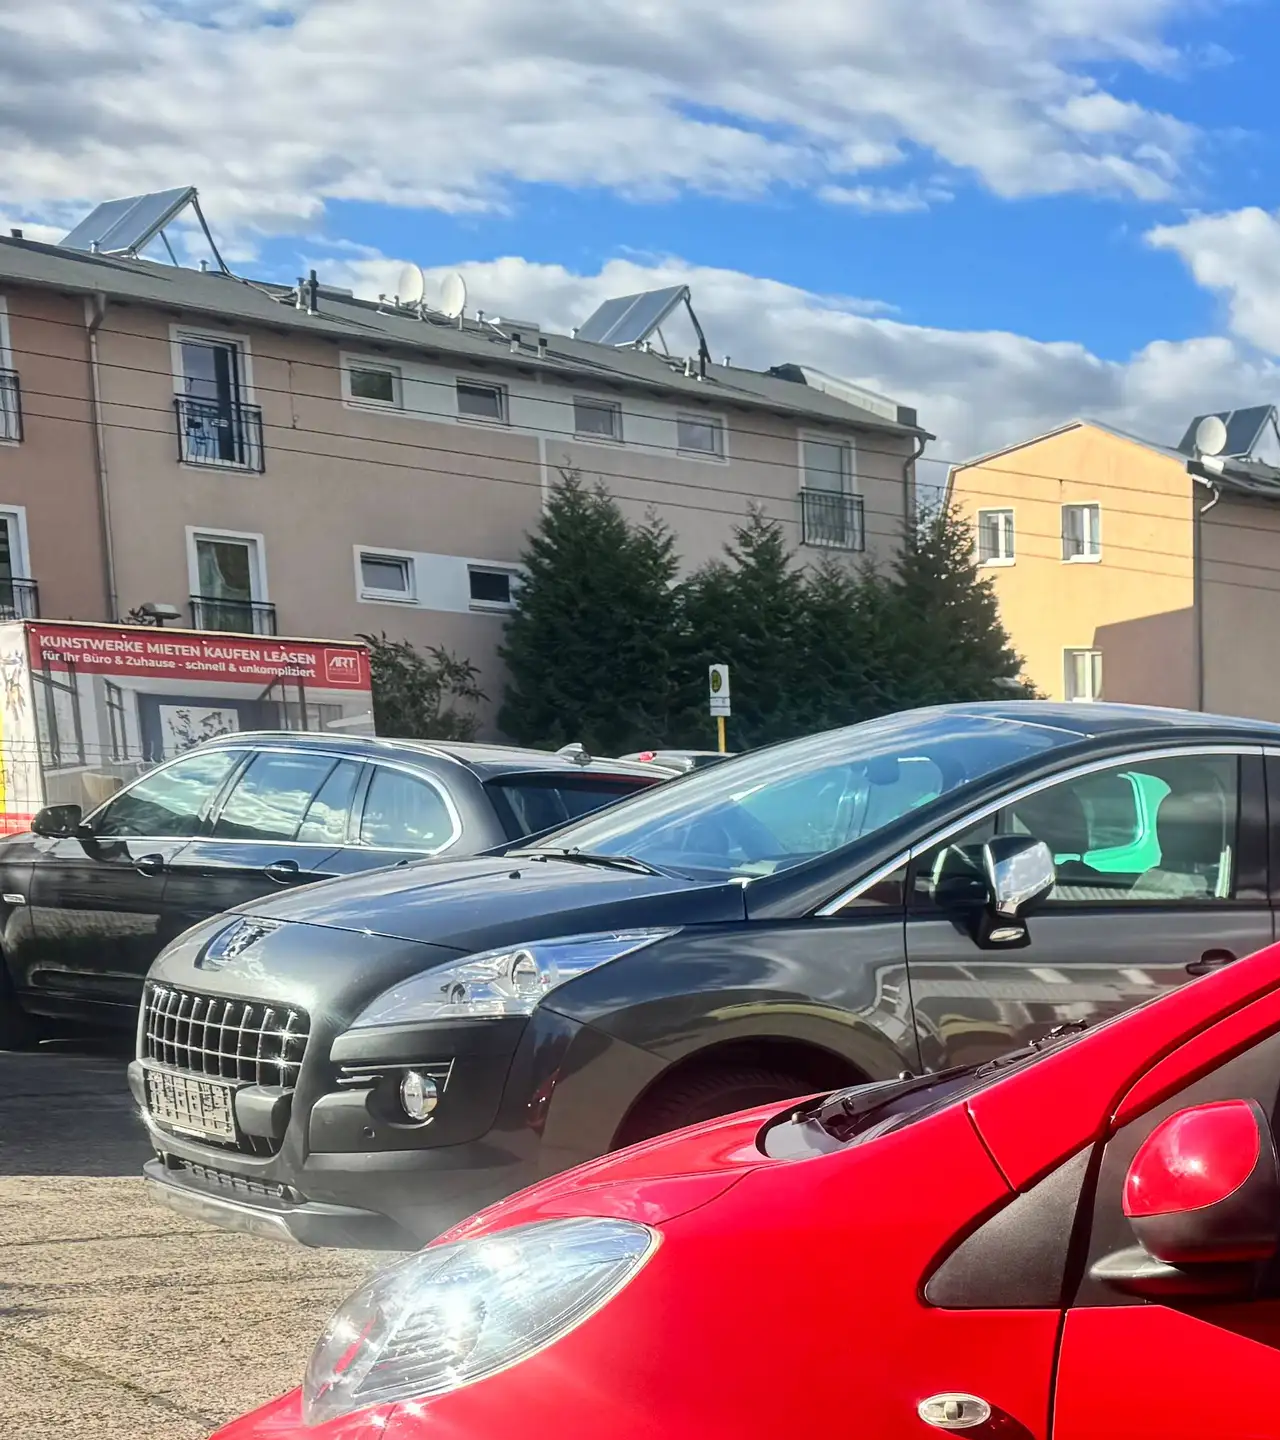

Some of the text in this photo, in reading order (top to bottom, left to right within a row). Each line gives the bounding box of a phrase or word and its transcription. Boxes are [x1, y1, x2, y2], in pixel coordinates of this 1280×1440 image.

[40, 635, 316, 665] KUNSTWERKE MIETEN KAUFEN LEASEN
[42, 650, 60, 662] für
[63, 652, 80, 663] Ihr
[83, 653, 112, 665] Büro
[115, 655, 124, 666] &
[125, 656, 176, 669] Zuhause
[185, 660, 225, 672] schnell
[228, 664, 237, 673] &
[239, 664, 316, 678] unkompliziert
[329, 656, 356, 669] ART
